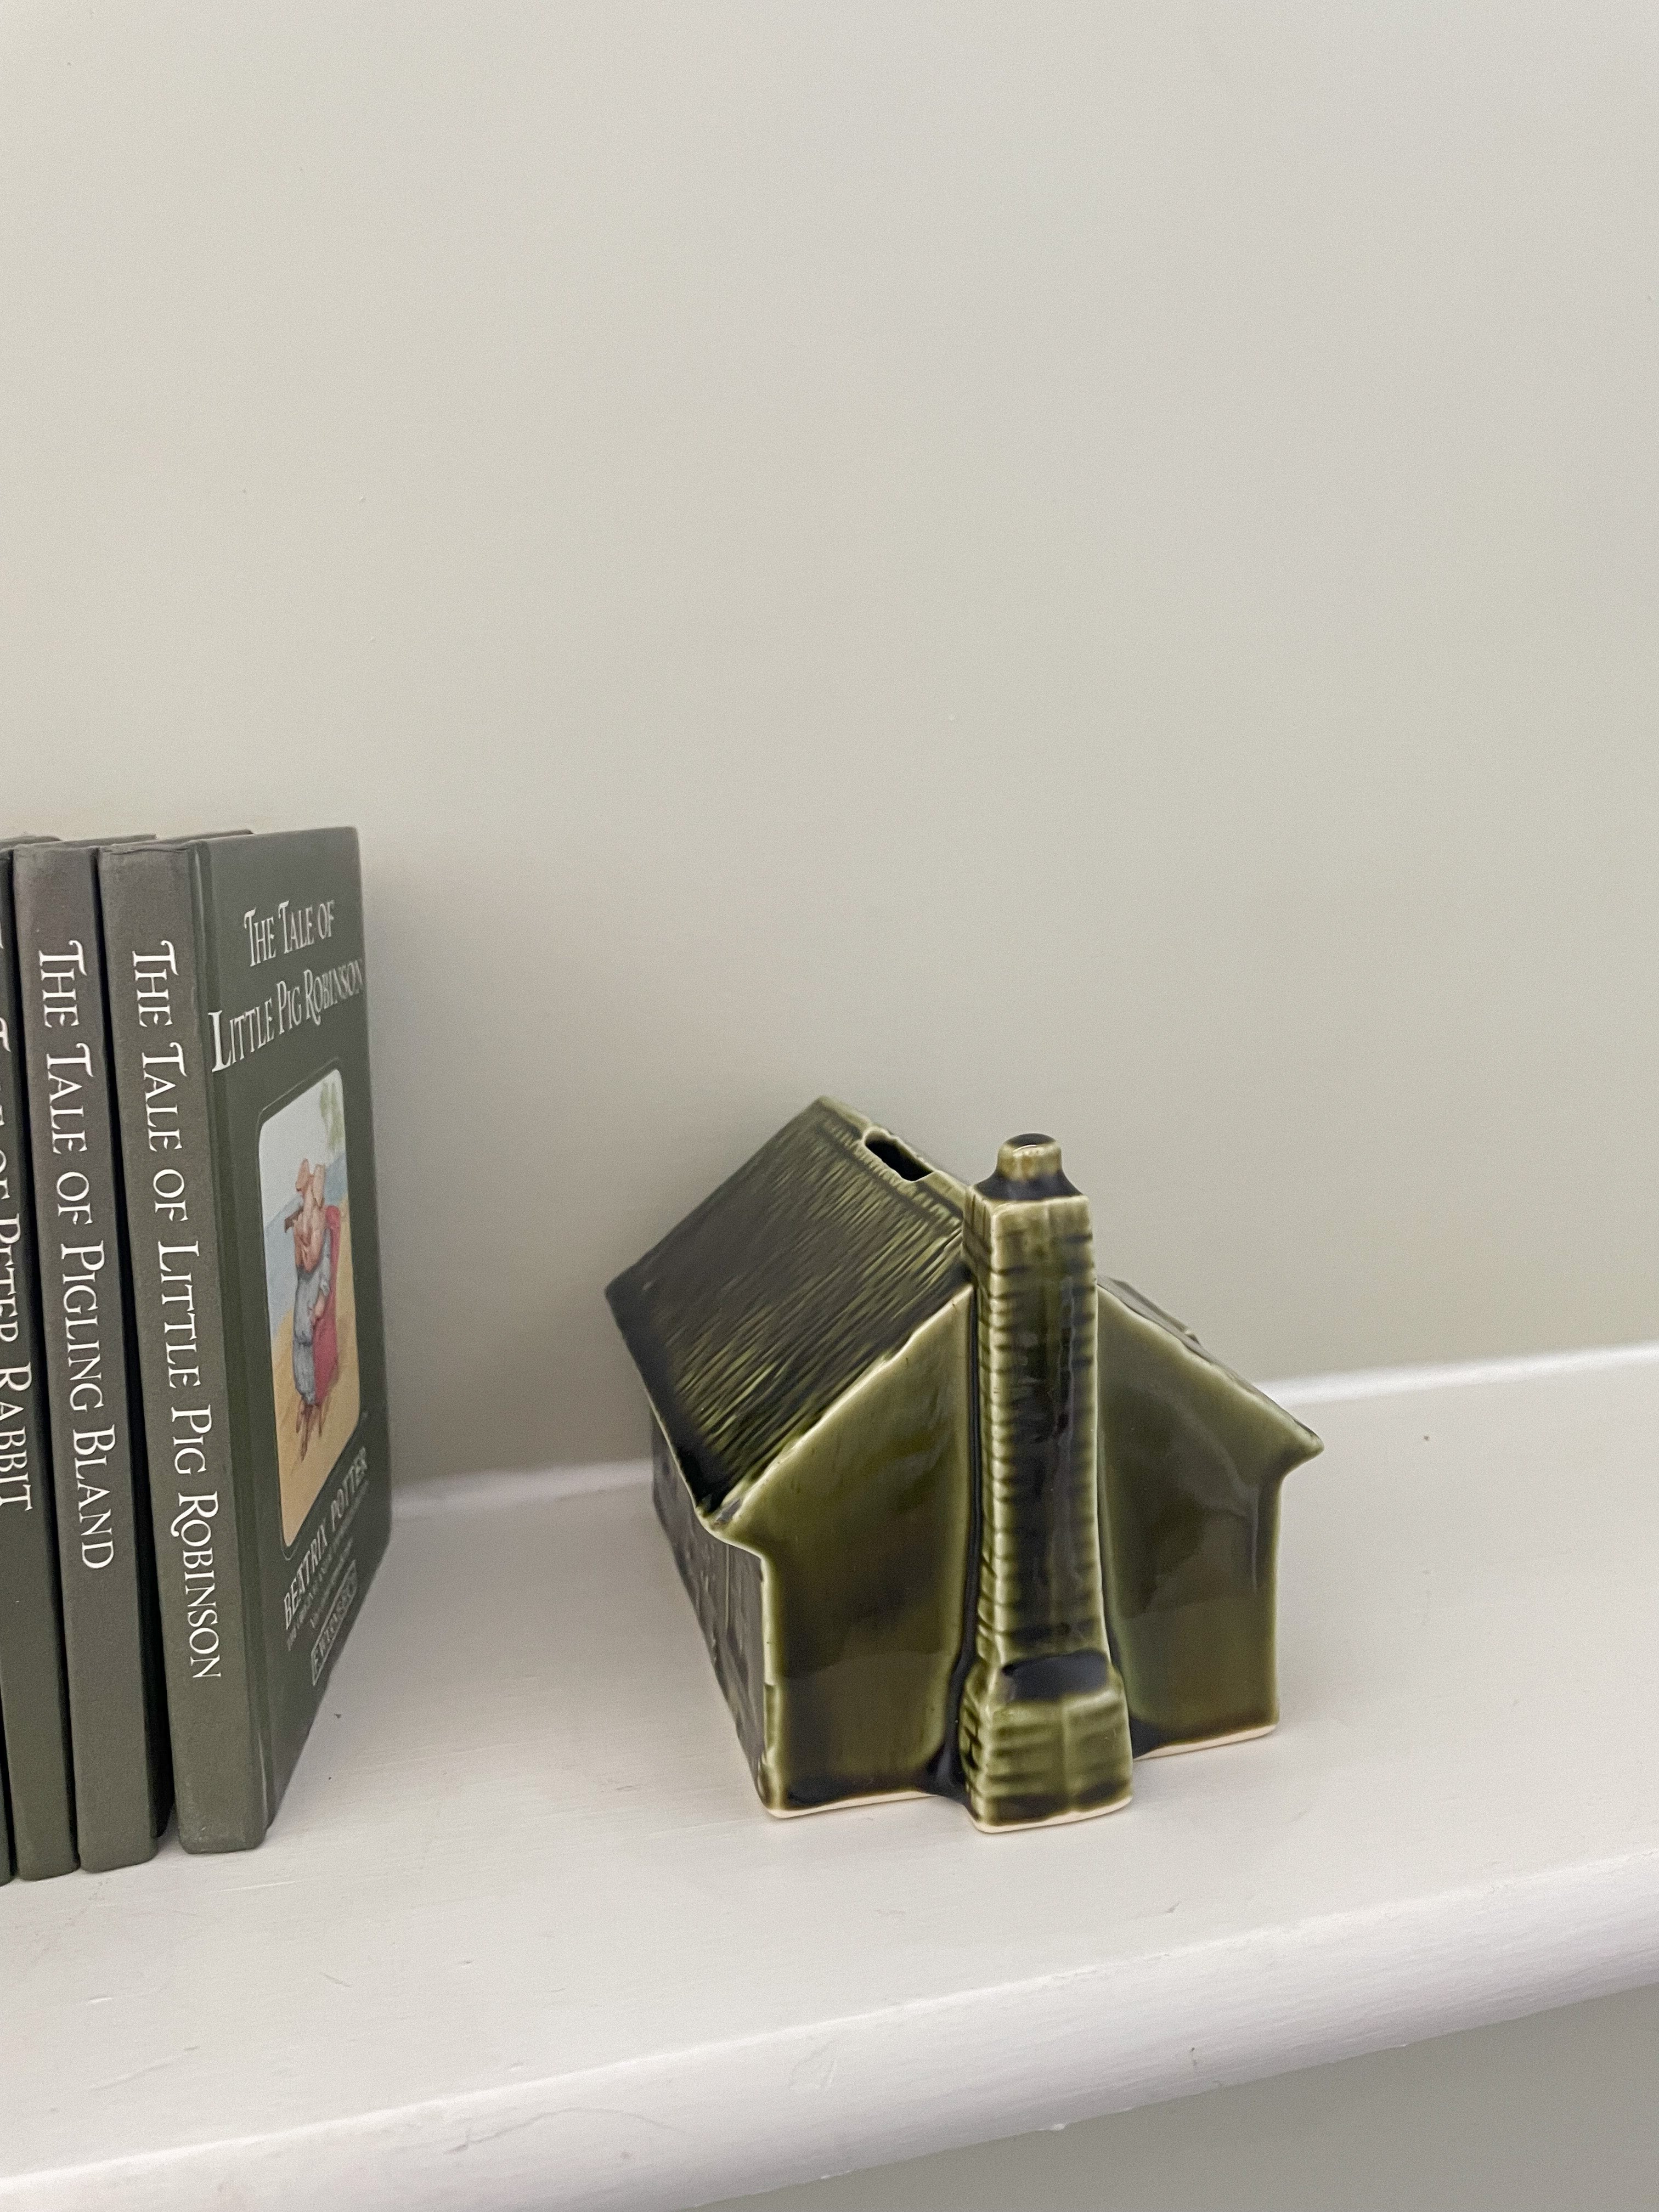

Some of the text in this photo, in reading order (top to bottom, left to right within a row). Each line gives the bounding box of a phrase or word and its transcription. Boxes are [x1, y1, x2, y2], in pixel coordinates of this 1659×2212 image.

[244, 899, 335, 967] THE TALE OF
[208, 959, 364, 1073] LITTLE PIG ROBINSON
[38, 940, 116, 1569] THE TALE OF PIGLING BLAND
[132, 940, 221, 1678] THE TALE OF LITTLE PIG ROBINSON
[284, 1517, 328, 1630] BEATRIX
